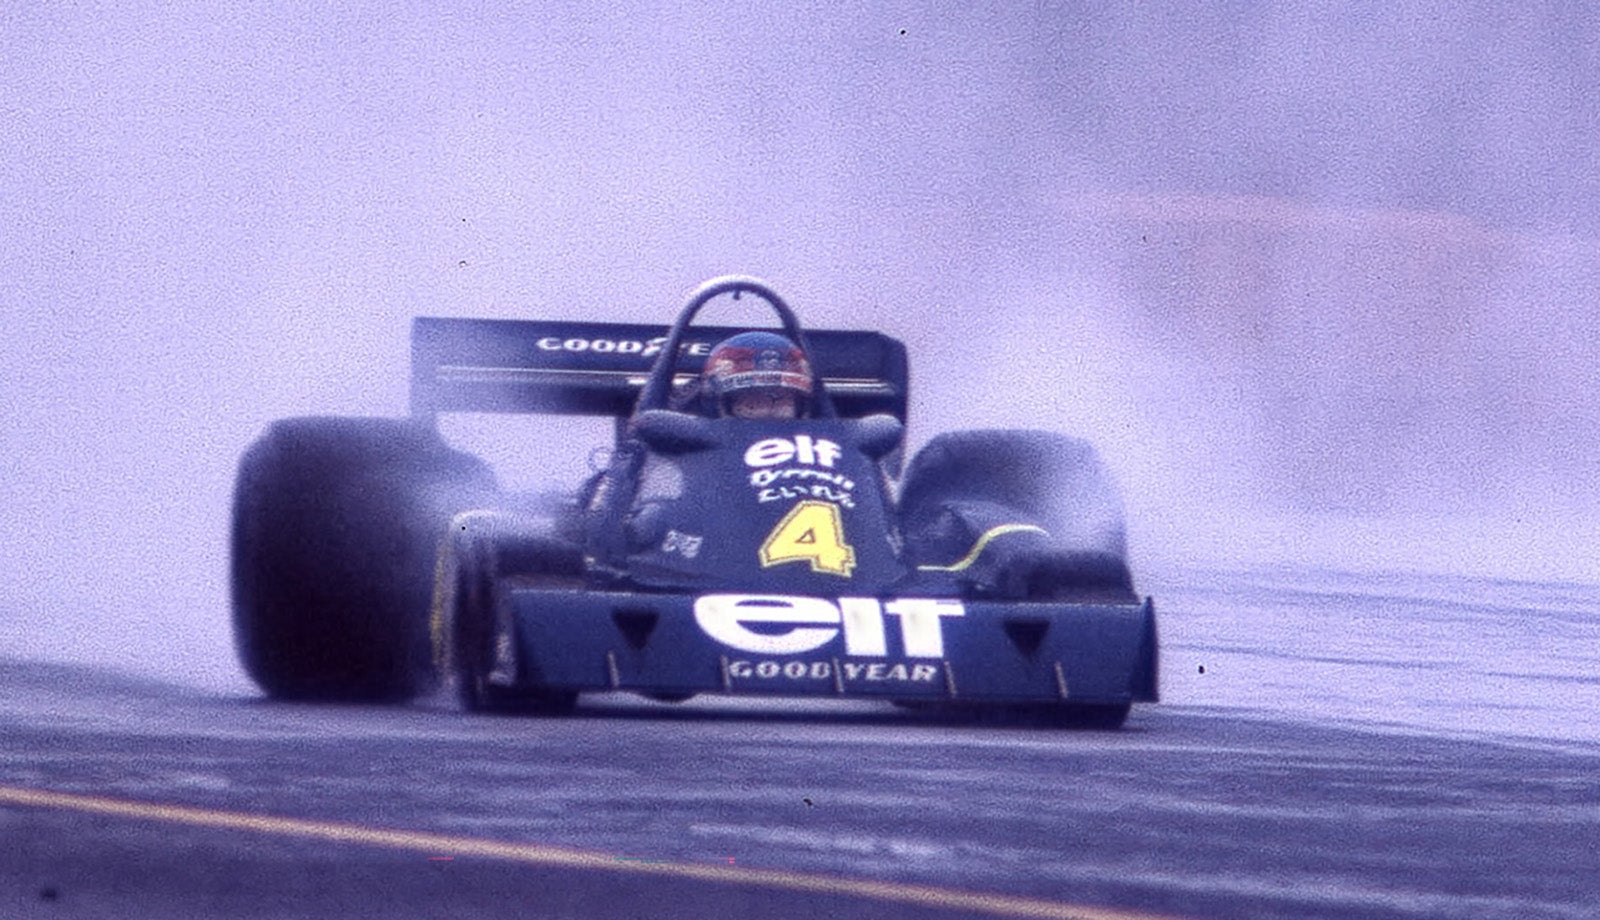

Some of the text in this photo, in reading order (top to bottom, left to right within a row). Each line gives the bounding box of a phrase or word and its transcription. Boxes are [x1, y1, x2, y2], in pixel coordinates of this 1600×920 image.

[744, 435, 842, 468] elf
[758, 499, 857, 578] 4
[693, 593, 965, 658] elf
[729, 661, 937, 682] GOOD YEAR
